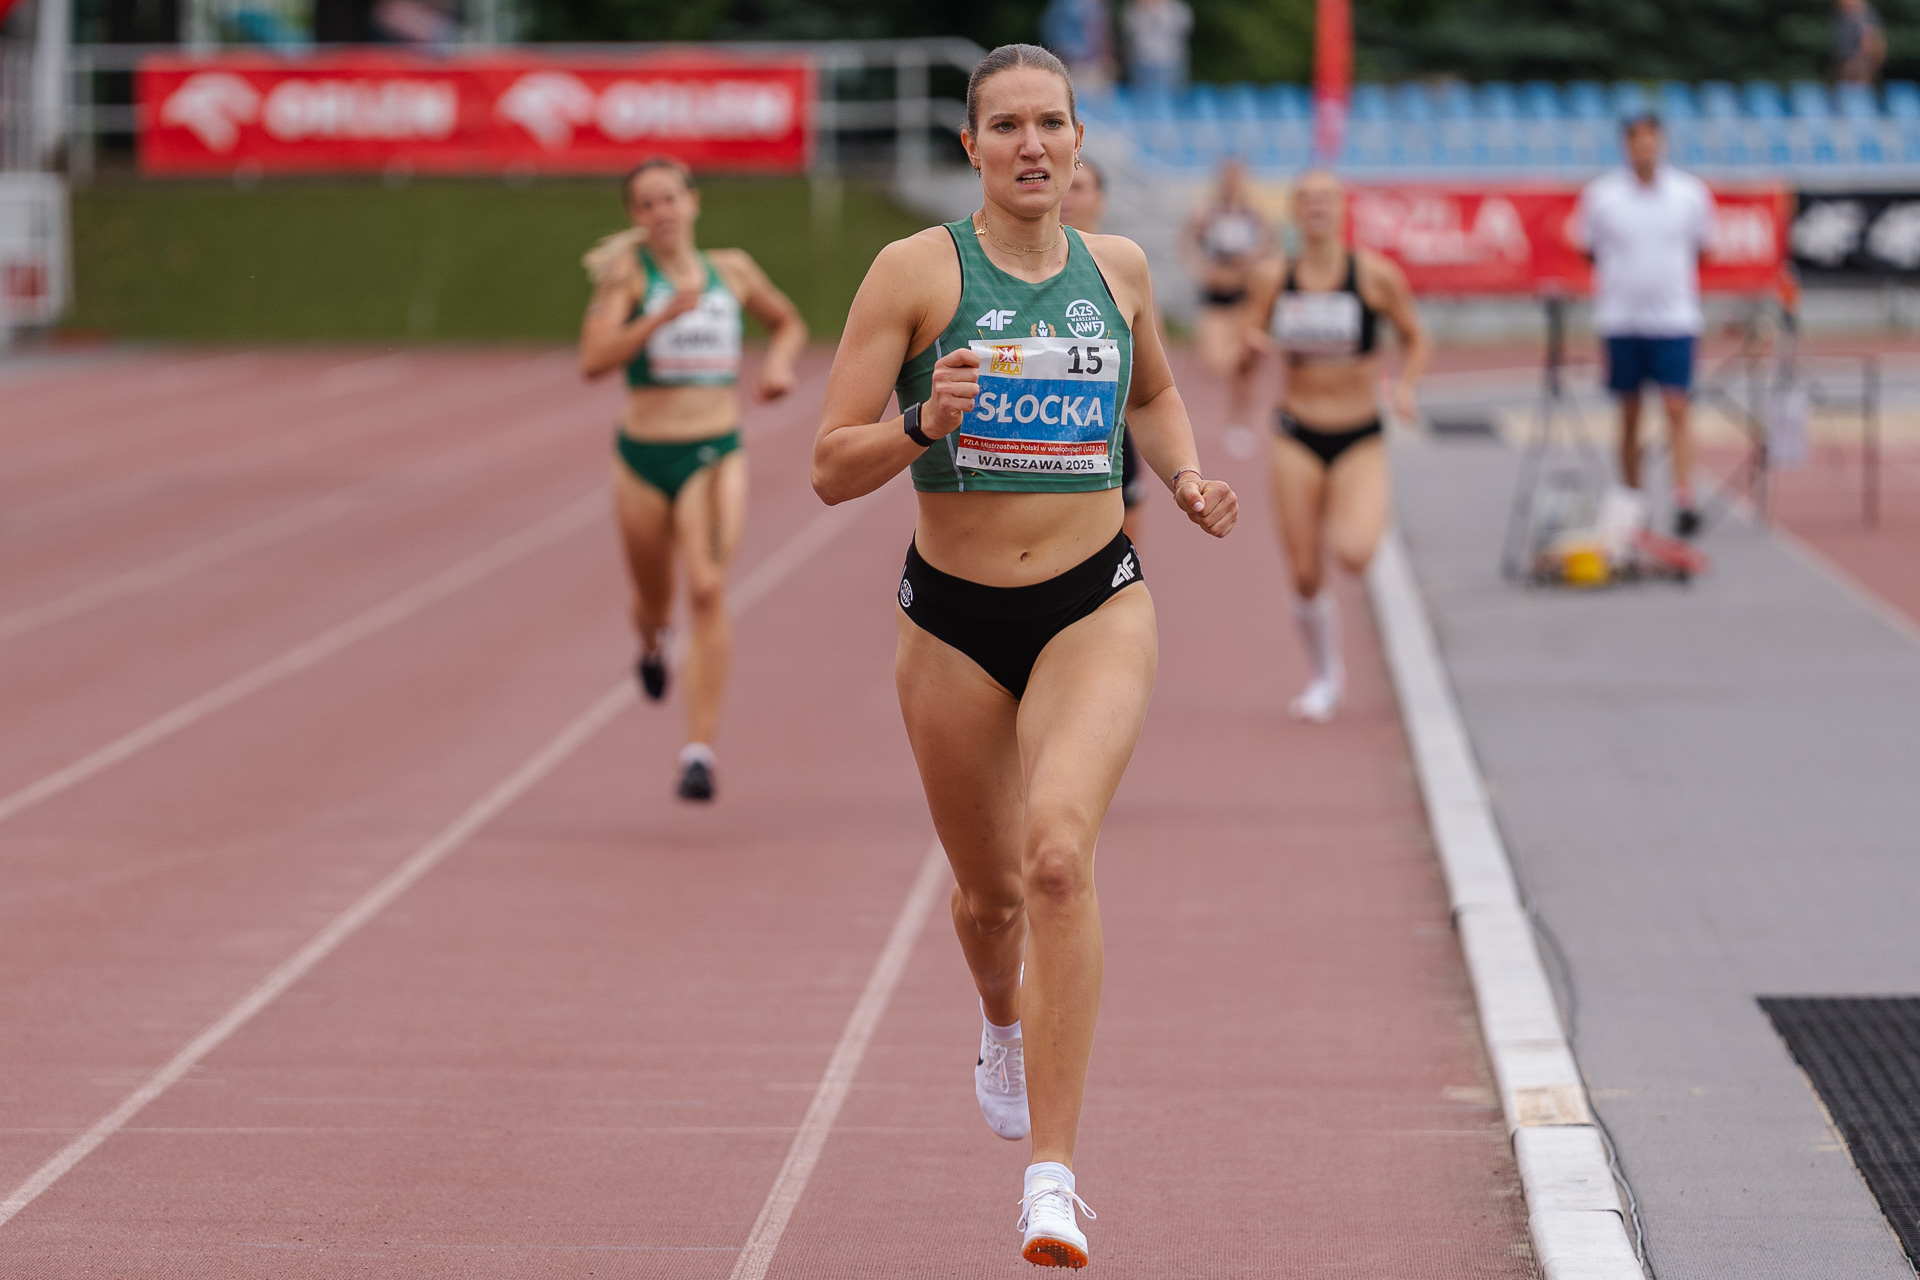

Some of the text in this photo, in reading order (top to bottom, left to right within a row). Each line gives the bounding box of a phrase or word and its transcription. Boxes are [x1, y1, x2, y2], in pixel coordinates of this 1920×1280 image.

[1072, 306, 1094, 317] AZS
[976, 309, 1017, 331] 4F
[1076, 322, 1100, 333] AWF
[1067, 345, 1103, 375] 15
[992, 363, 1020, 374] PZLA
[976, 391, 1104, 427] SŁOCKA
[963, 438, 979, 446] PZLA
[980, 441, 1019, 450] Mistrzostwa
[1020, 444, 1039, 452] Polski
[978, 455, 1095, 470] WARSZAWA 2025
[1111, 552, 1135, 588] 4F
